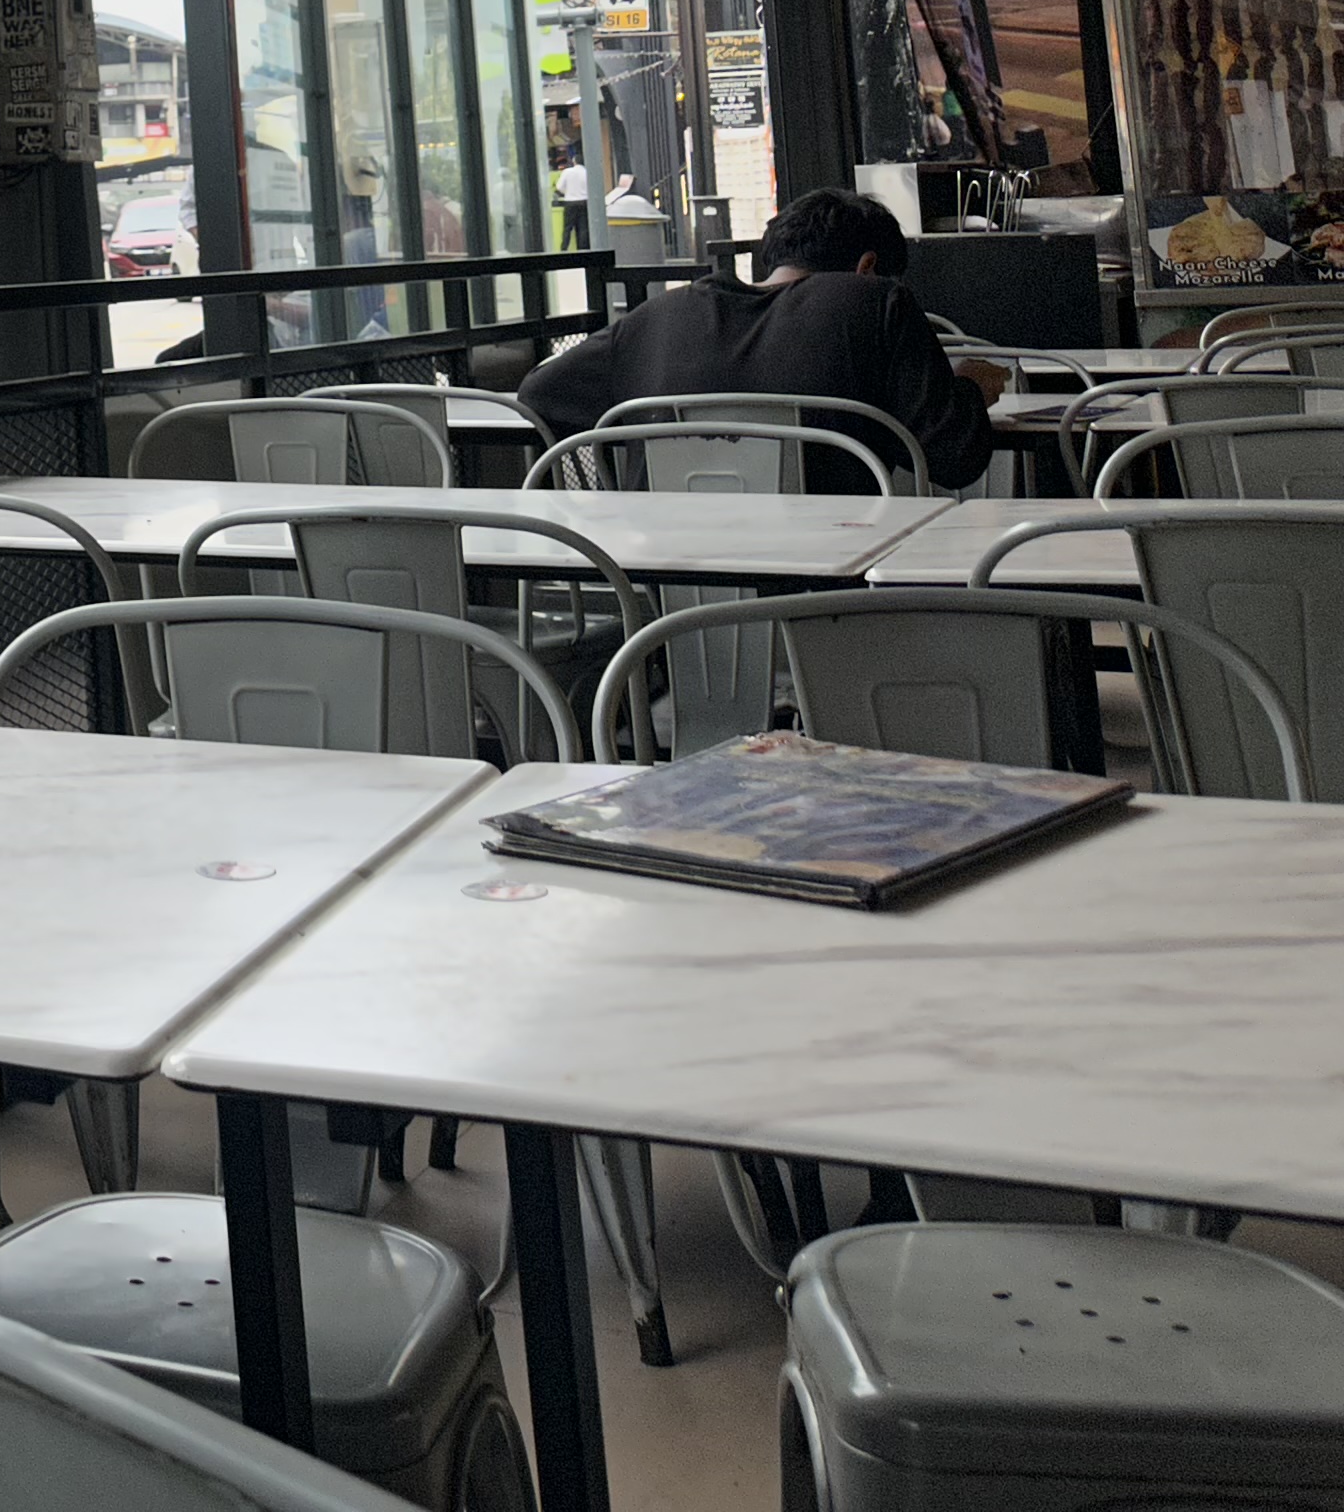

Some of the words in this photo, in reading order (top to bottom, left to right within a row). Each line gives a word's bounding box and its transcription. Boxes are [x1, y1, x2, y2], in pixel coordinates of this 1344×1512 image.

[626, 13, 640, 25] 16
[1158, 258, 1207, 272] Naan
[1214, 255, 1278, 270] Cheese
